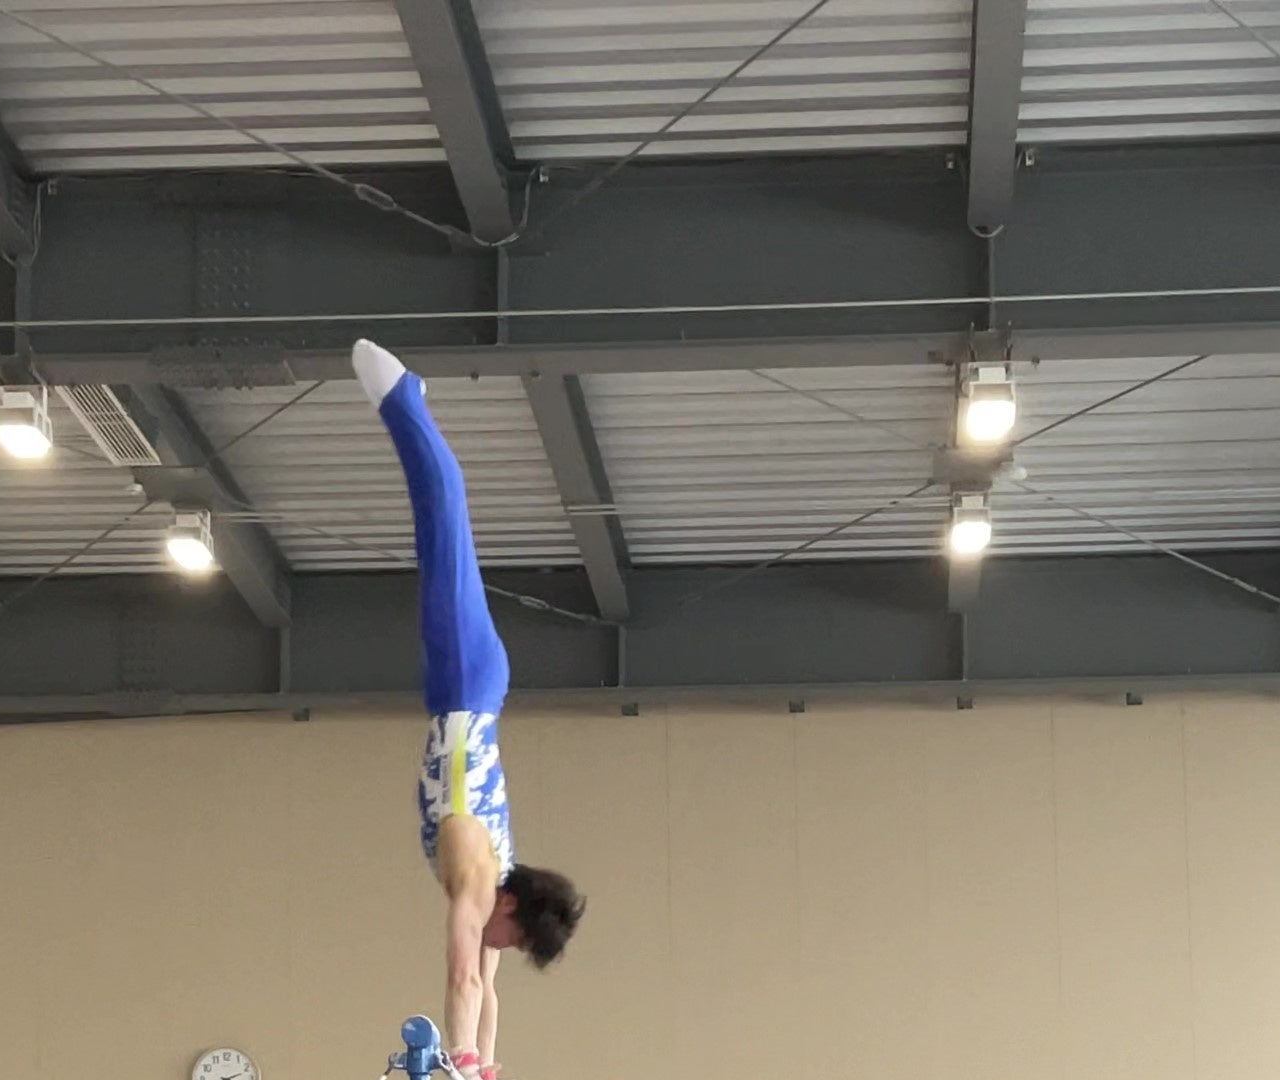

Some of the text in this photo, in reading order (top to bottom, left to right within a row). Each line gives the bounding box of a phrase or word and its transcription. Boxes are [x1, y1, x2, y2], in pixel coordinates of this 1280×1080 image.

[213, 1055, 220, 1064] 11
[222, 1052, 231, 1061] 12
[203, 1064, 212, 1073] 10
[244, 1063, 250, 1072] 2
